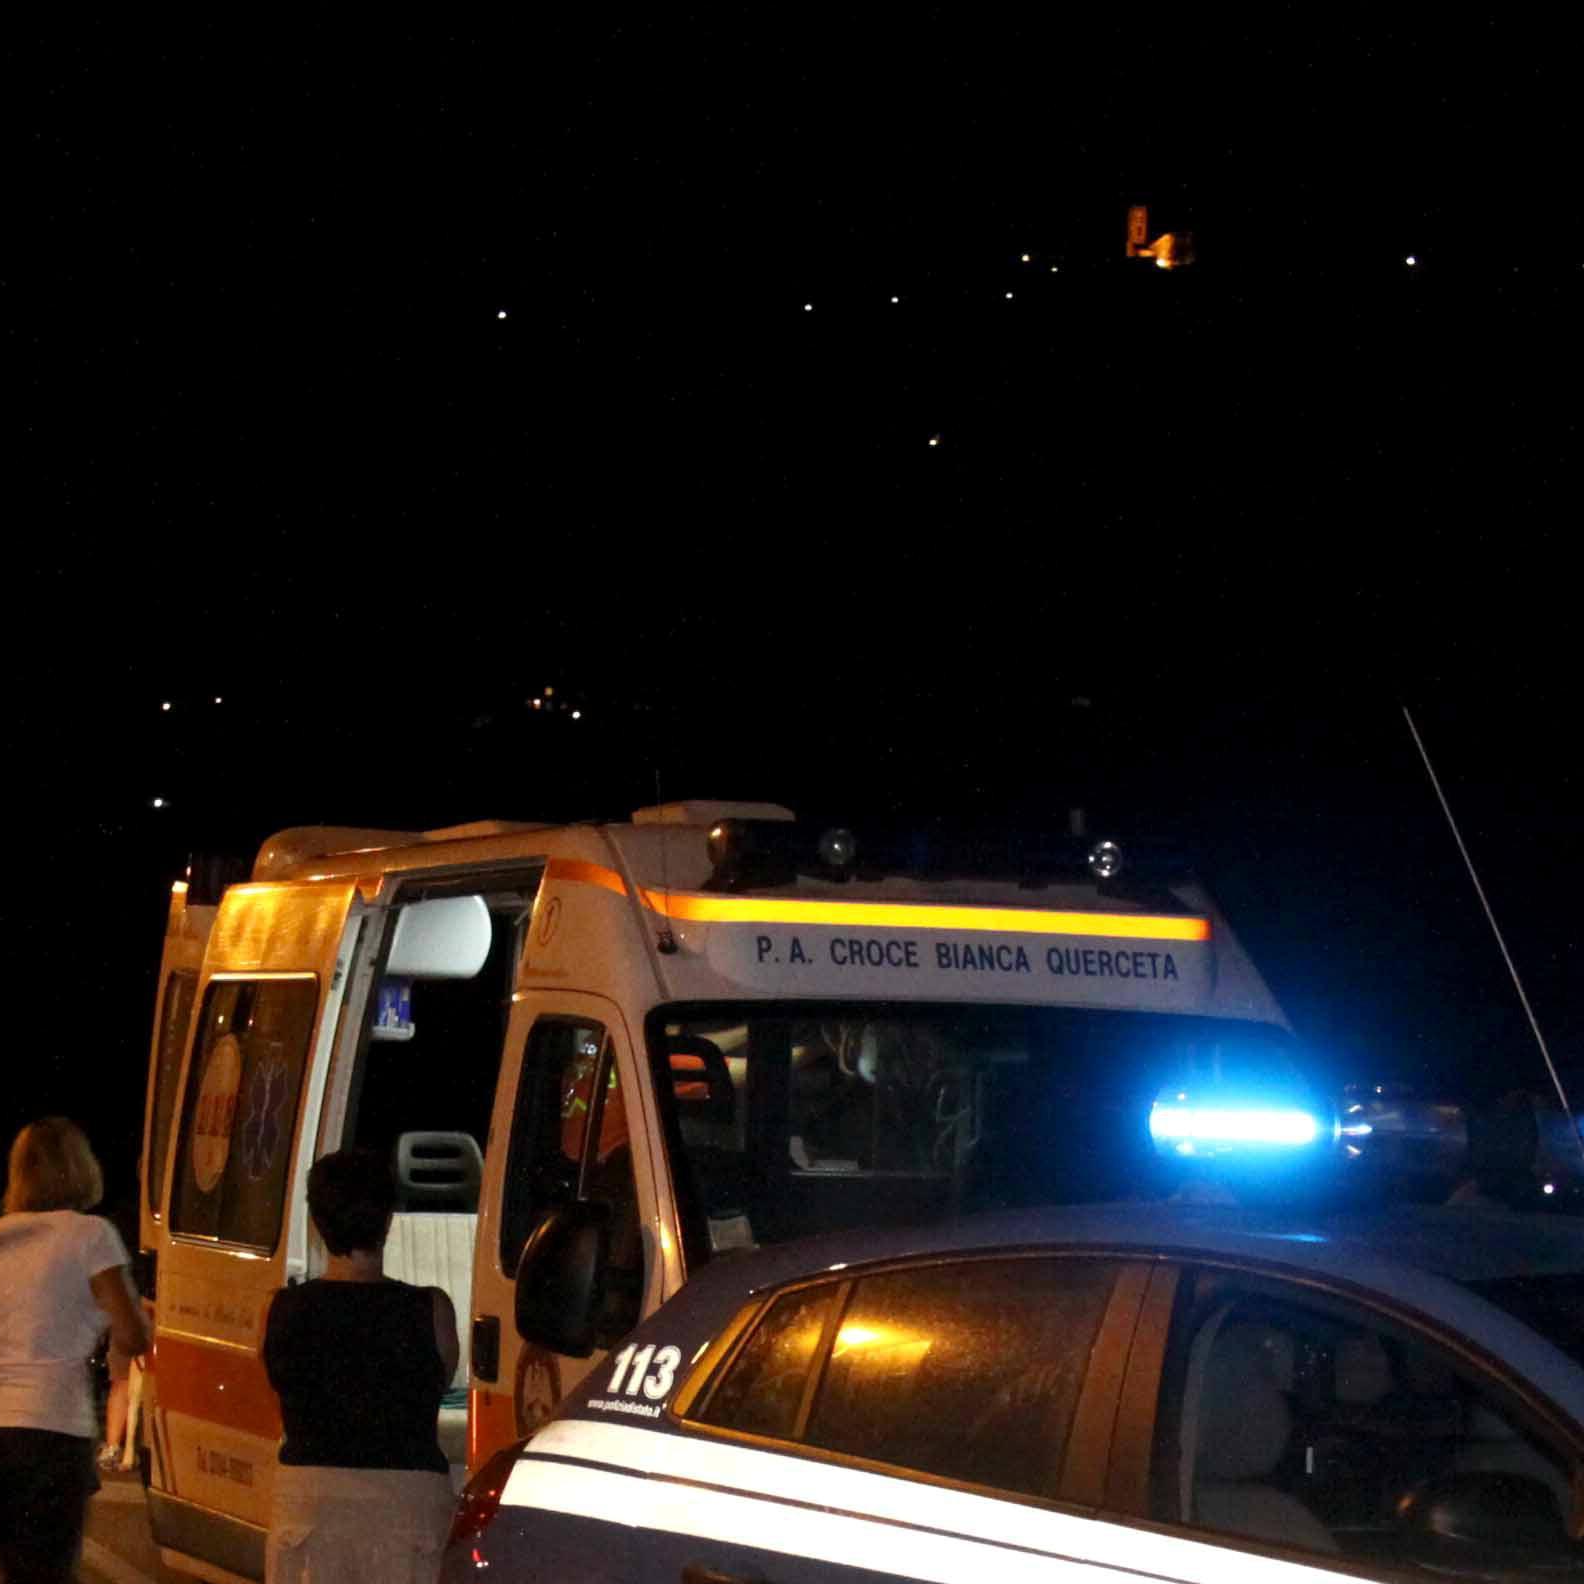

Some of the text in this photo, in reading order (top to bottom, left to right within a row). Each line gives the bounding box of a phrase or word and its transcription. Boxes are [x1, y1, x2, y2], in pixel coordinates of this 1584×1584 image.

[756, 936, 1178, 979] P. A. CROCE BIANCA QUERCETA
[606, 1342, 681, 1400] 113
